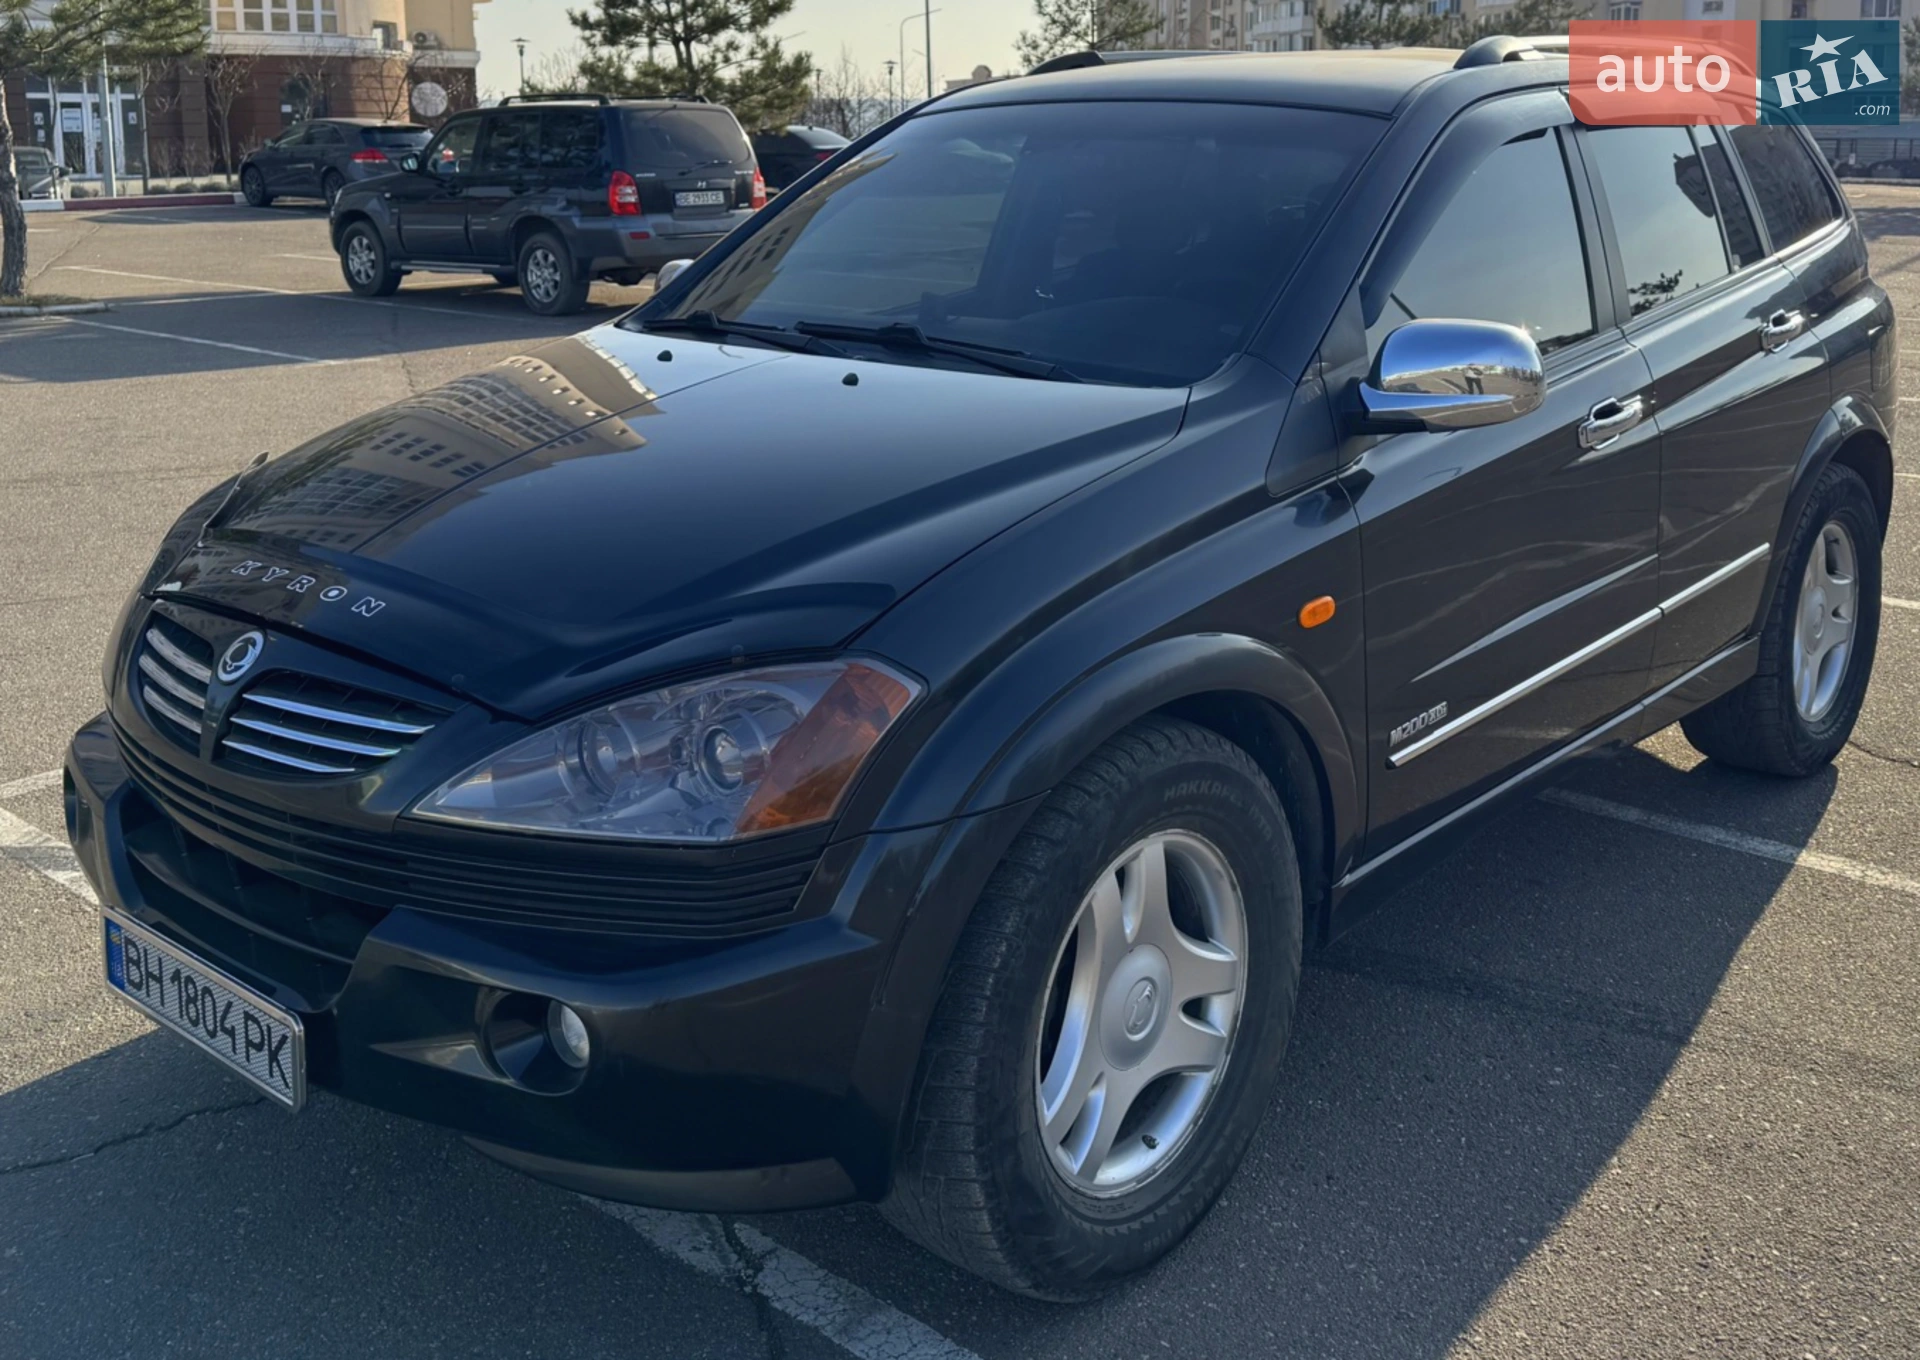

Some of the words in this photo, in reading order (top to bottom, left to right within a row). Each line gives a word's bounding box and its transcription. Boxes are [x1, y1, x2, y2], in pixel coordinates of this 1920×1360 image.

[231, 560, 387, 618] KYRON
[124, 936, 164, 1007] BH
[170, 968, 237, 1055] 1804
[244, 1011, 290, 1089] PK
